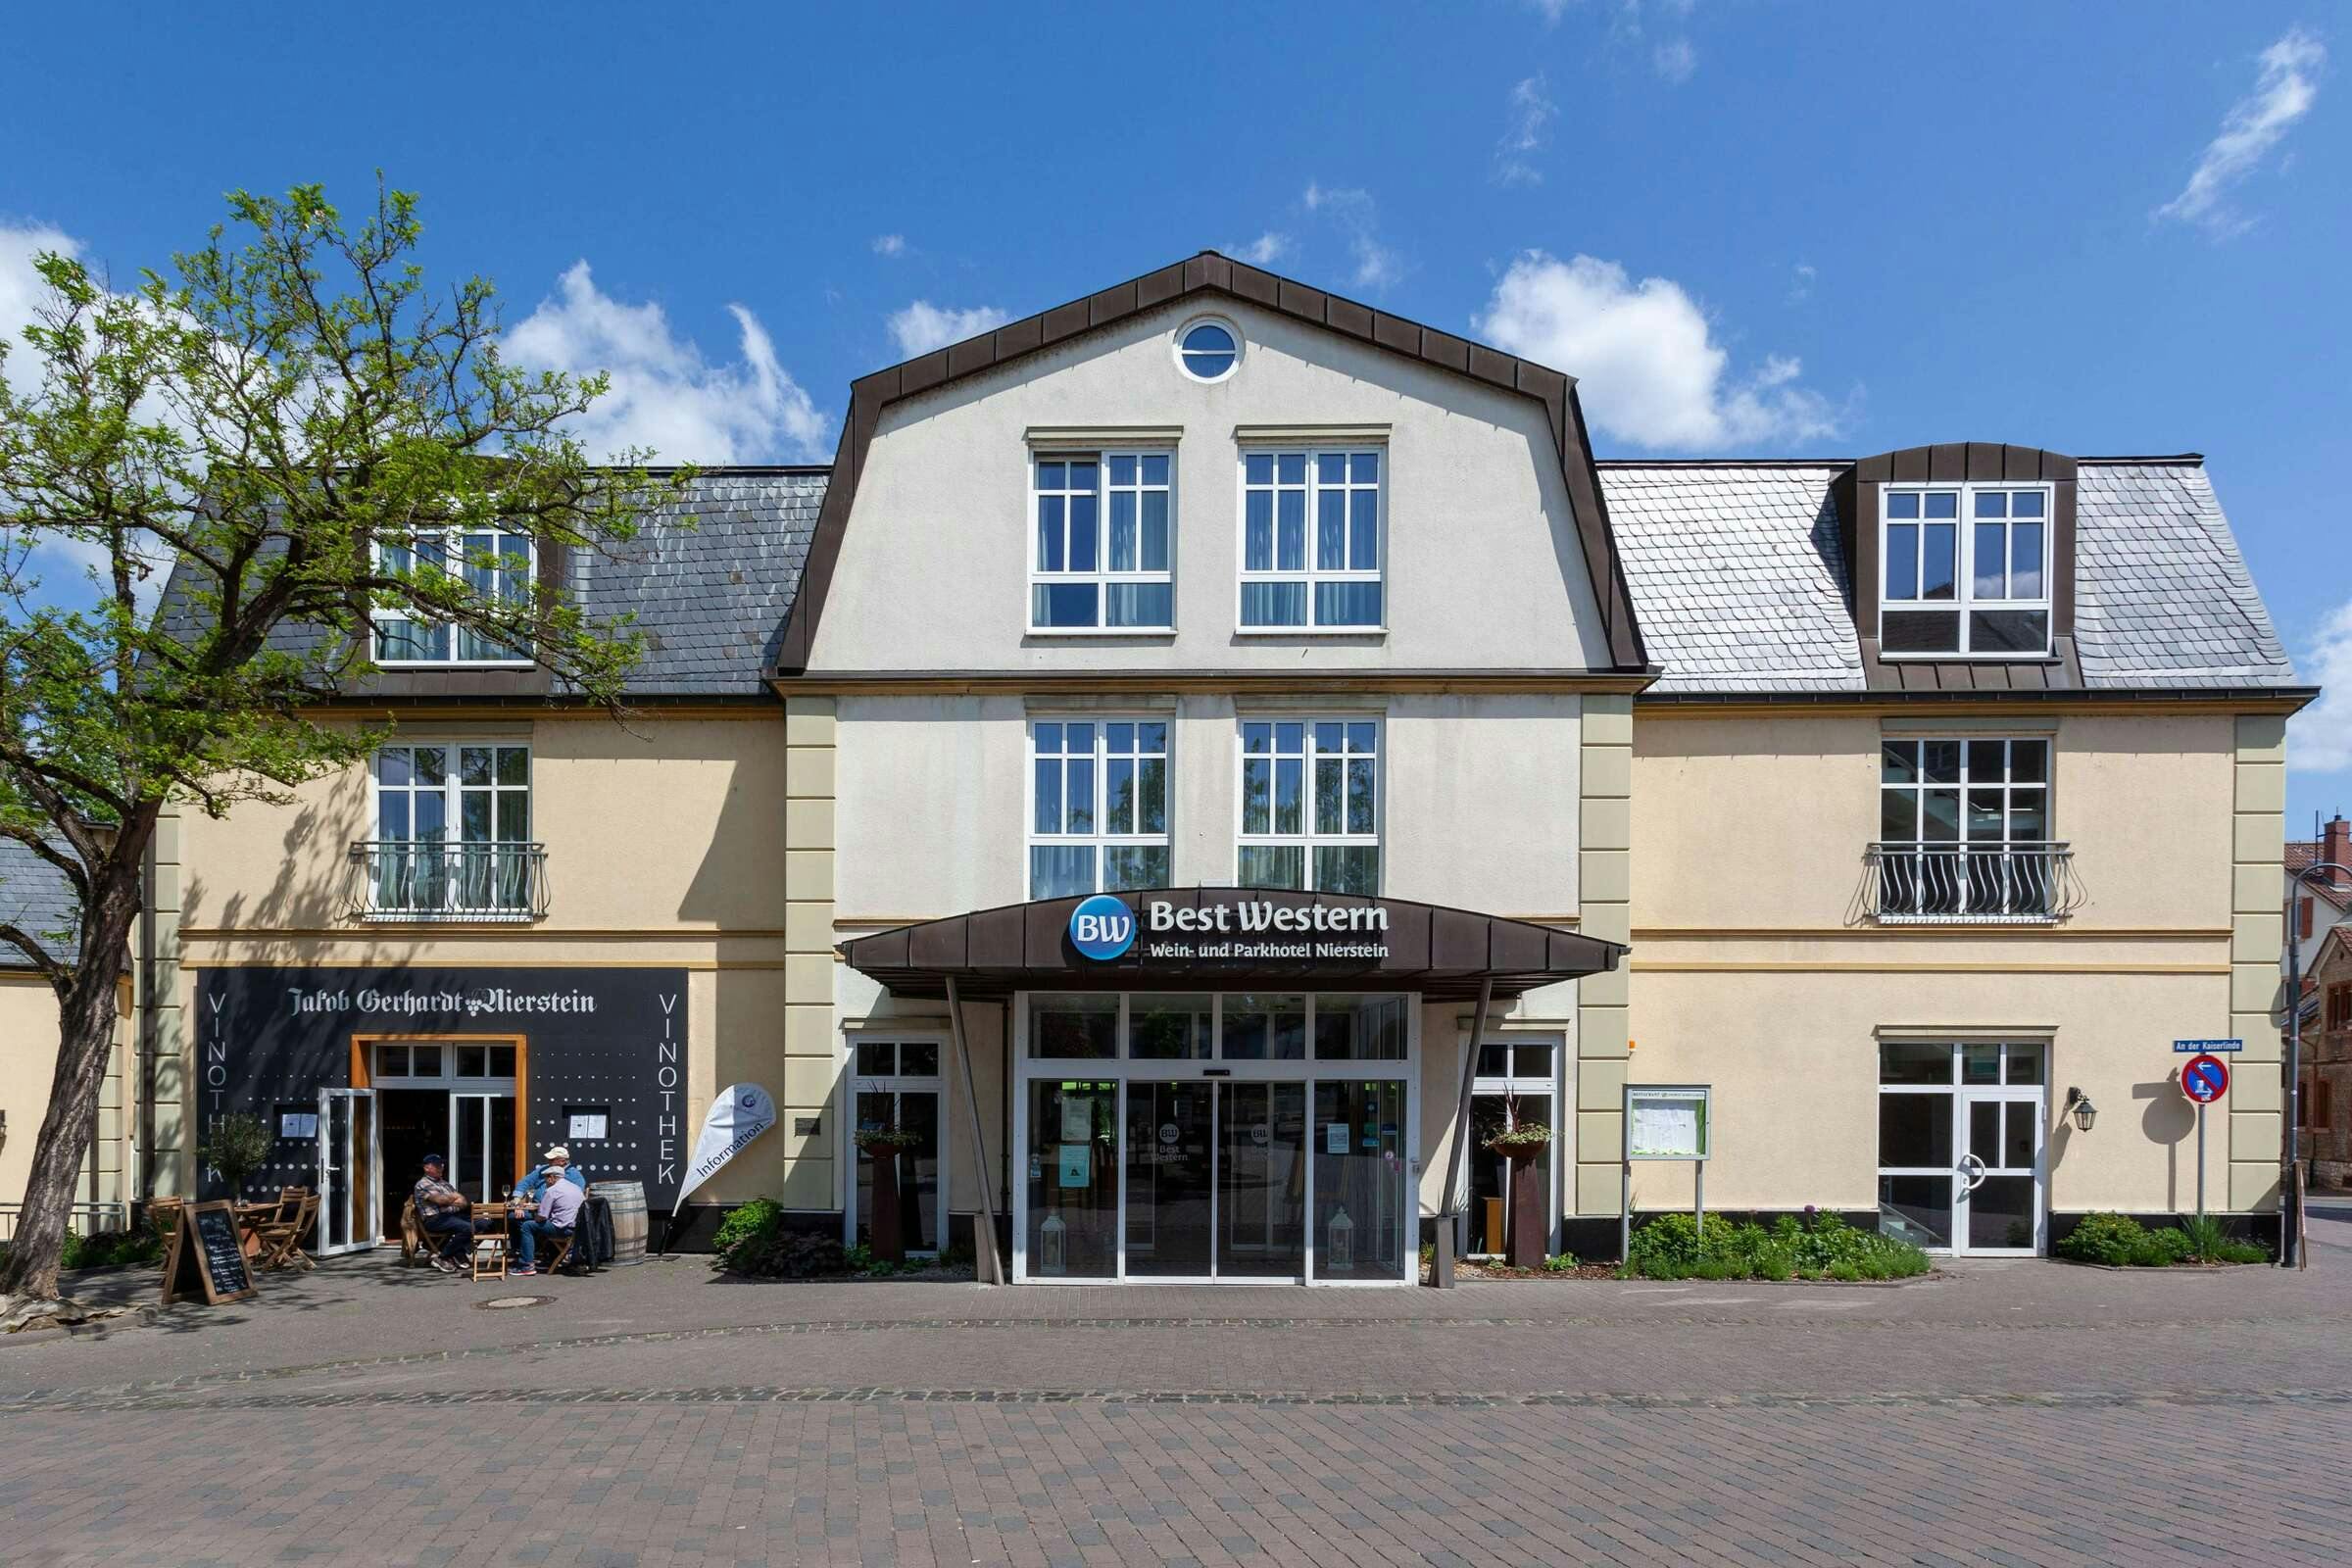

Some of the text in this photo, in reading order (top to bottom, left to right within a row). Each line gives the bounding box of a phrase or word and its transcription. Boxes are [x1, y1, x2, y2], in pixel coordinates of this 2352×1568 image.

[1077, 914, 1129, 942] BW
[1150, 901, 1389, 931] Best Western
[1150, 943, 1389, 957] Wein- und Parkhotel Nierstein
[287, 988, 597, 1016] Jakob Gerhardt Nierstein
[2176, 1042, 2185, 1051] An
[2187, 1042, 2200, 1051] der
[658, 994, 677, 1184] VINOTHEK
[696, 1122, 764, 1178] Information
